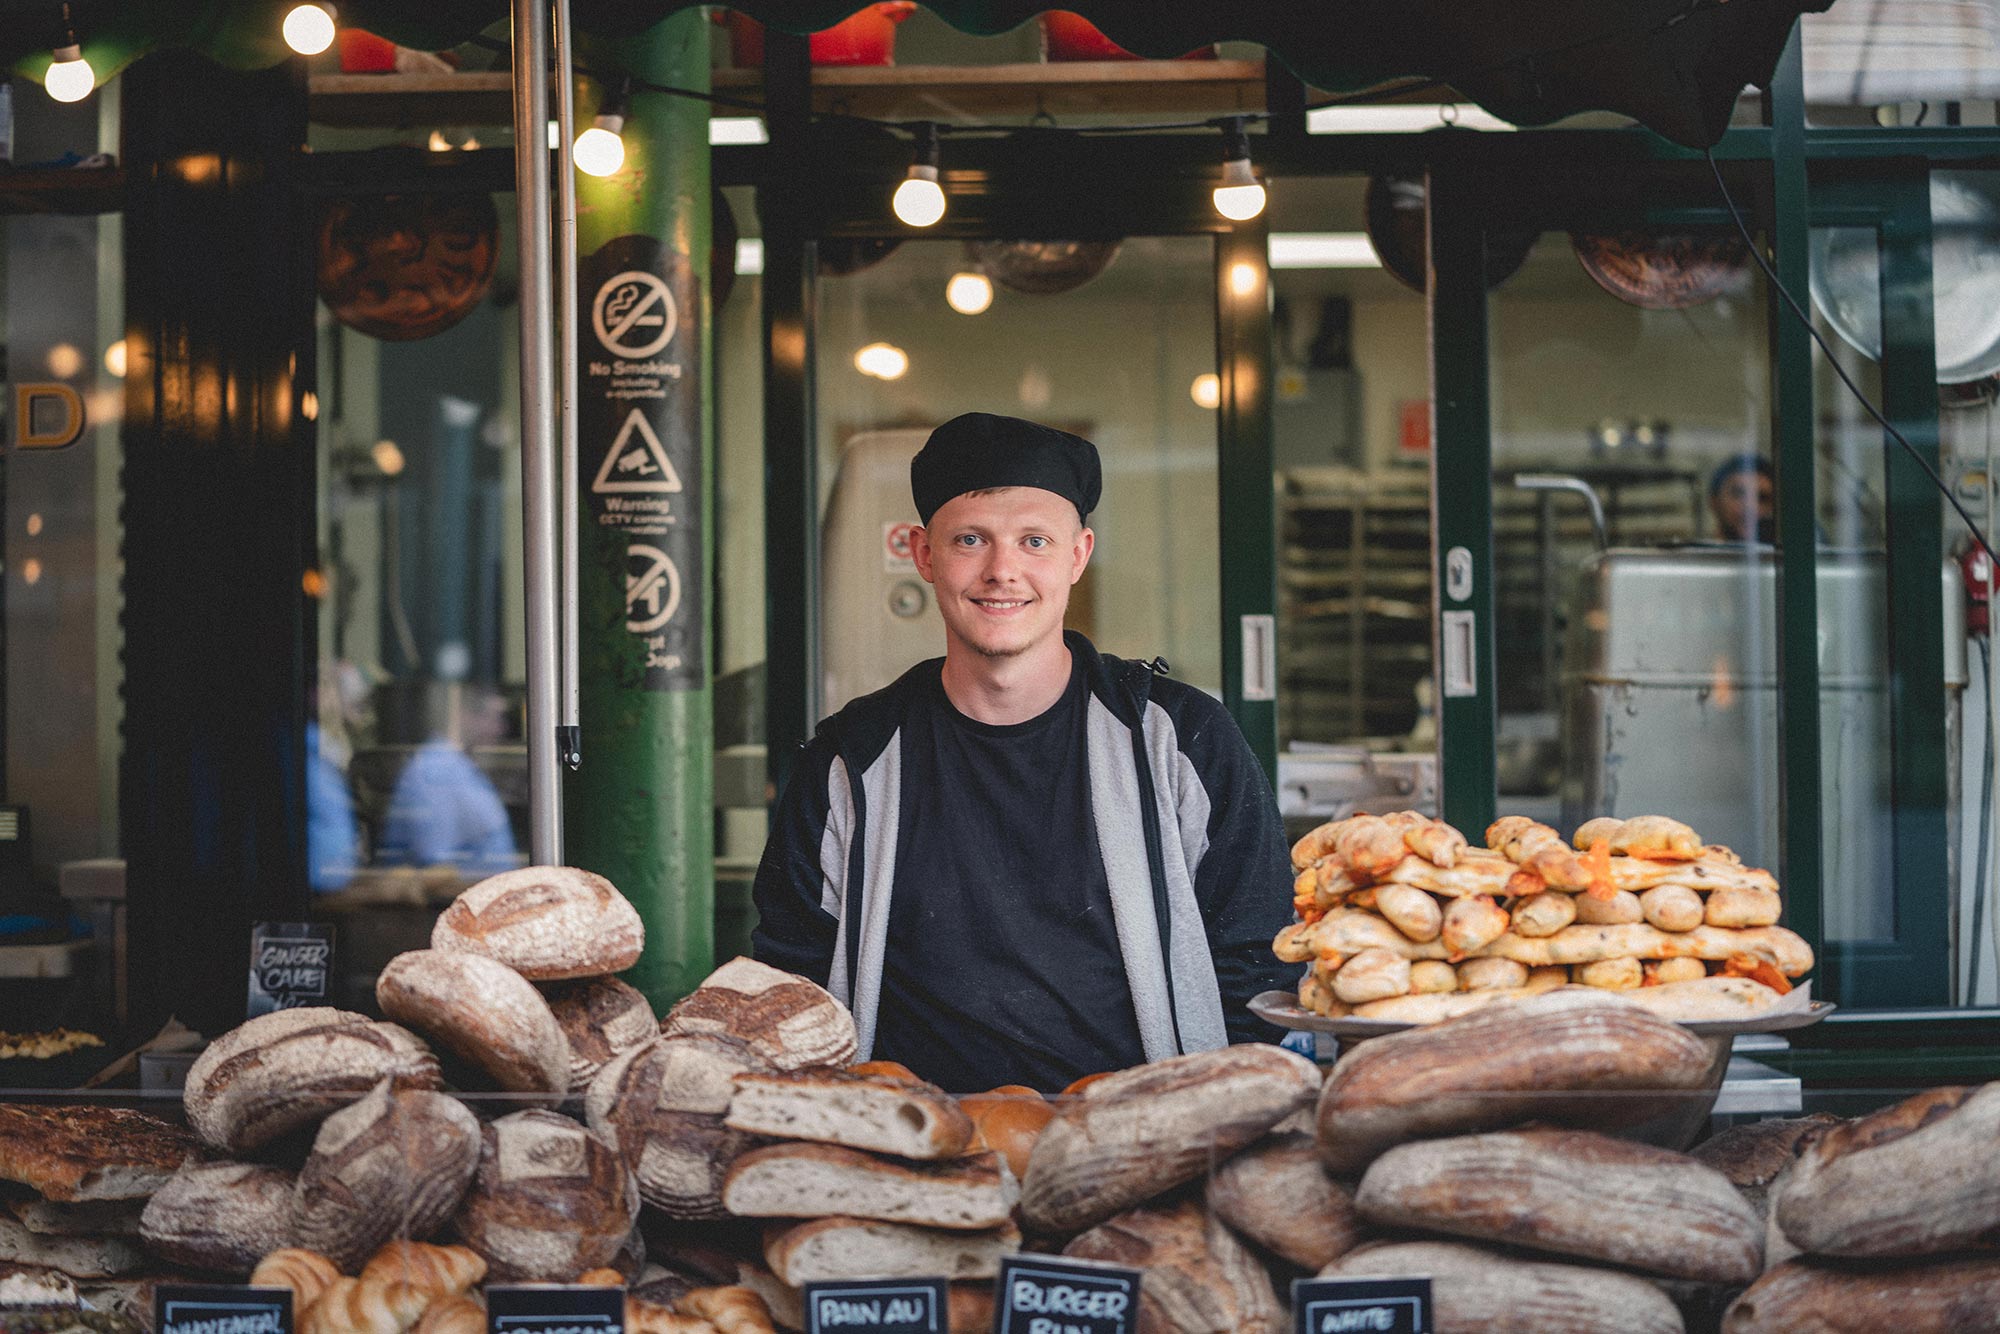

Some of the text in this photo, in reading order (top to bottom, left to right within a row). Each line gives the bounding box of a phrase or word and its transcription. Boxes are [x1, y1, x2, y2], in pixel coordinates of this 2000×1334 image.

[590, 360, 681, 378] No Smoking
[605, 497, 669, 514] Warning
[599, 513, 633, 525] CCTV
[260, 945, 329, 969] GINGER
[264, 968, 321, 990] CAKE
[1013, 1281, 1128, 1320] BURGER
[820, 1298, 924, 1327] PAIN AU
[1321, 1306, 1396, 1333] WHITE
